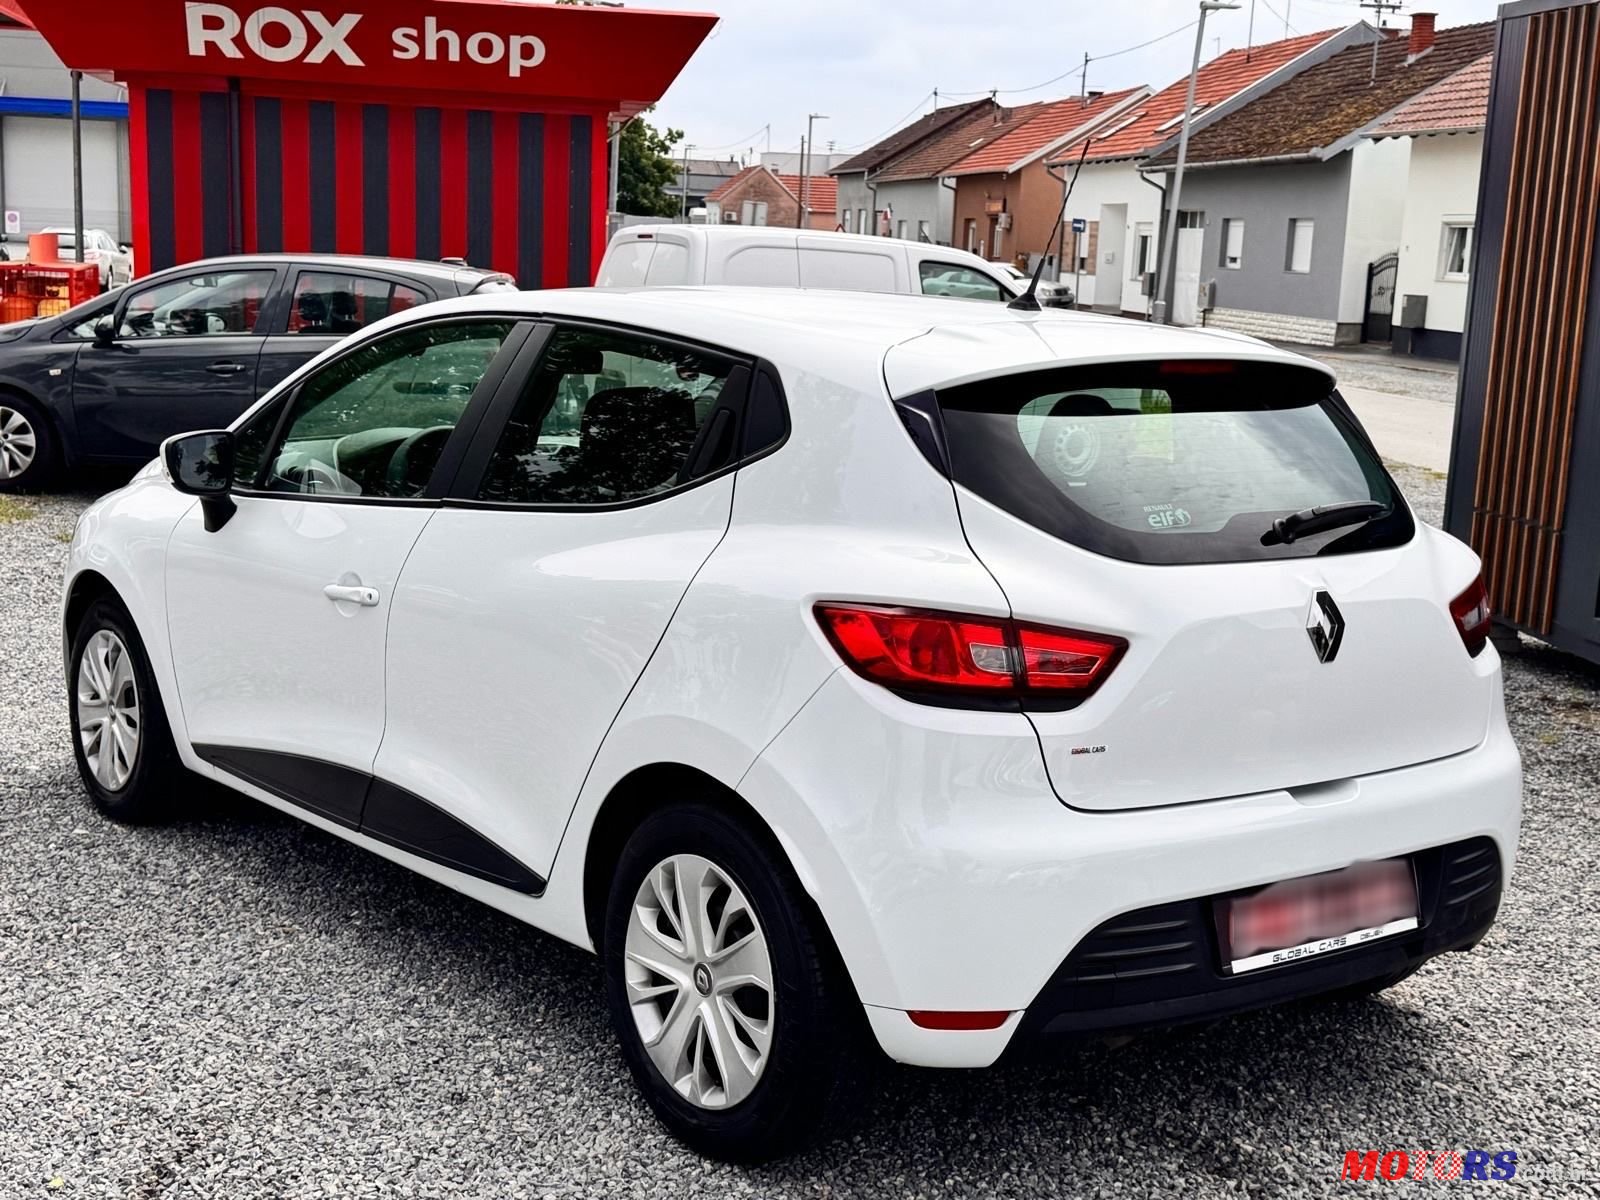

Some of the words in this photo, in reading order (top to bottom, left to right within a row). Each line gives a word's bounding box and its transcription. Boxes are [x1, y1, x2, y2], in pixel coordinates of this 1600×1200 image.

[185, 1, 366, 67] ROX
[391, 16, 546, 77] shop
[1272, 946, 1315, 963] GLOBAL
[1319, 937, 1347, 952] CARS
